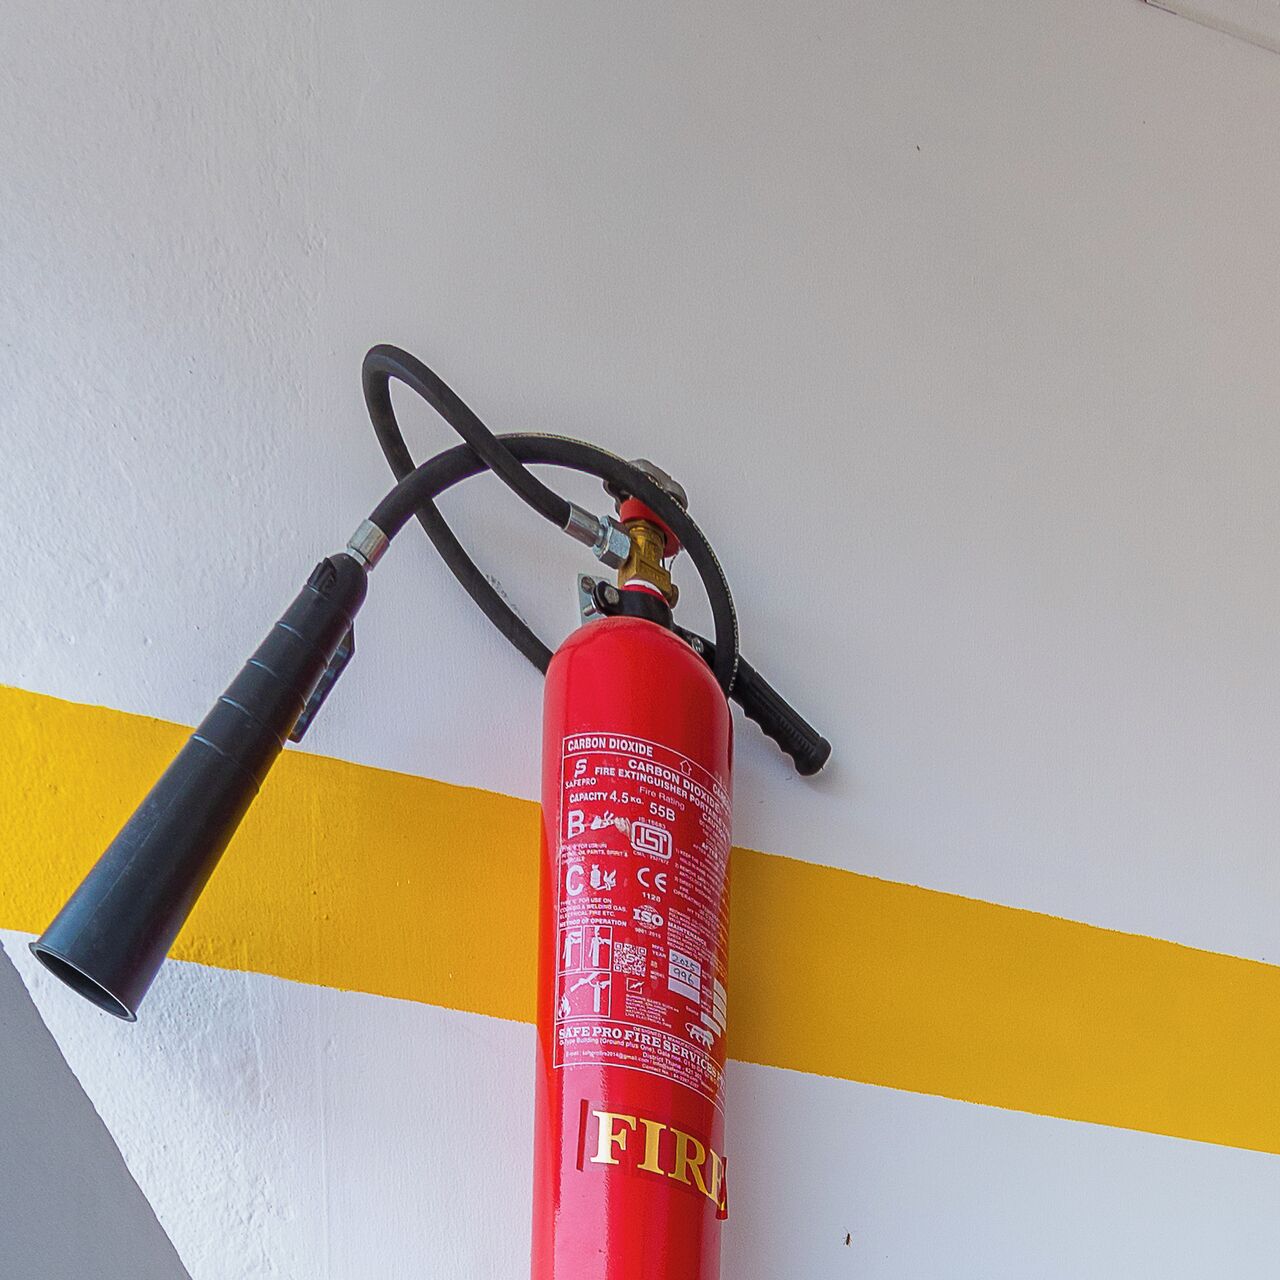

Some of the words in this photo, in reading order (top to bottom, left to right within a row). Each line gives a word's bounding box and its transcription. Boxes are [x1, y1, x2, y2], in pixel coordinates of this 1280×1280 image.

[567, 737, 606, 752] CARBON
[609, 738, 653, 757] DIOXIDE
[565, 777, 597, 790] SAFEPRO
[594, 766, 616, 776] FIRE
[618, 768, 688, 799] EXTINGUISHER
[628, 759, 680, 785] CARBON
[683, 778, 720, 813] DIOXIDE
[569, 792, 608, 804] CAPACITY
[609, 790, 629, 804] 4.5
[639, 786, 657, 798] Fire
[658, 791, 685, 811] Rating
[649, 802, 676, 822] 55B
[567, 809, 586, 840] B
[565, 865, 585, 897] C
[590, 918, 627, 927] OPERATION
[633, 908, 664, 927] ISO
[559, 1026, 590, 1039] SAFE
[592, 1026, 623, 1039] PRO
[624, 1028, 660, 1048] FIRE
[663, 1039, 716, 1079] SERVICES
